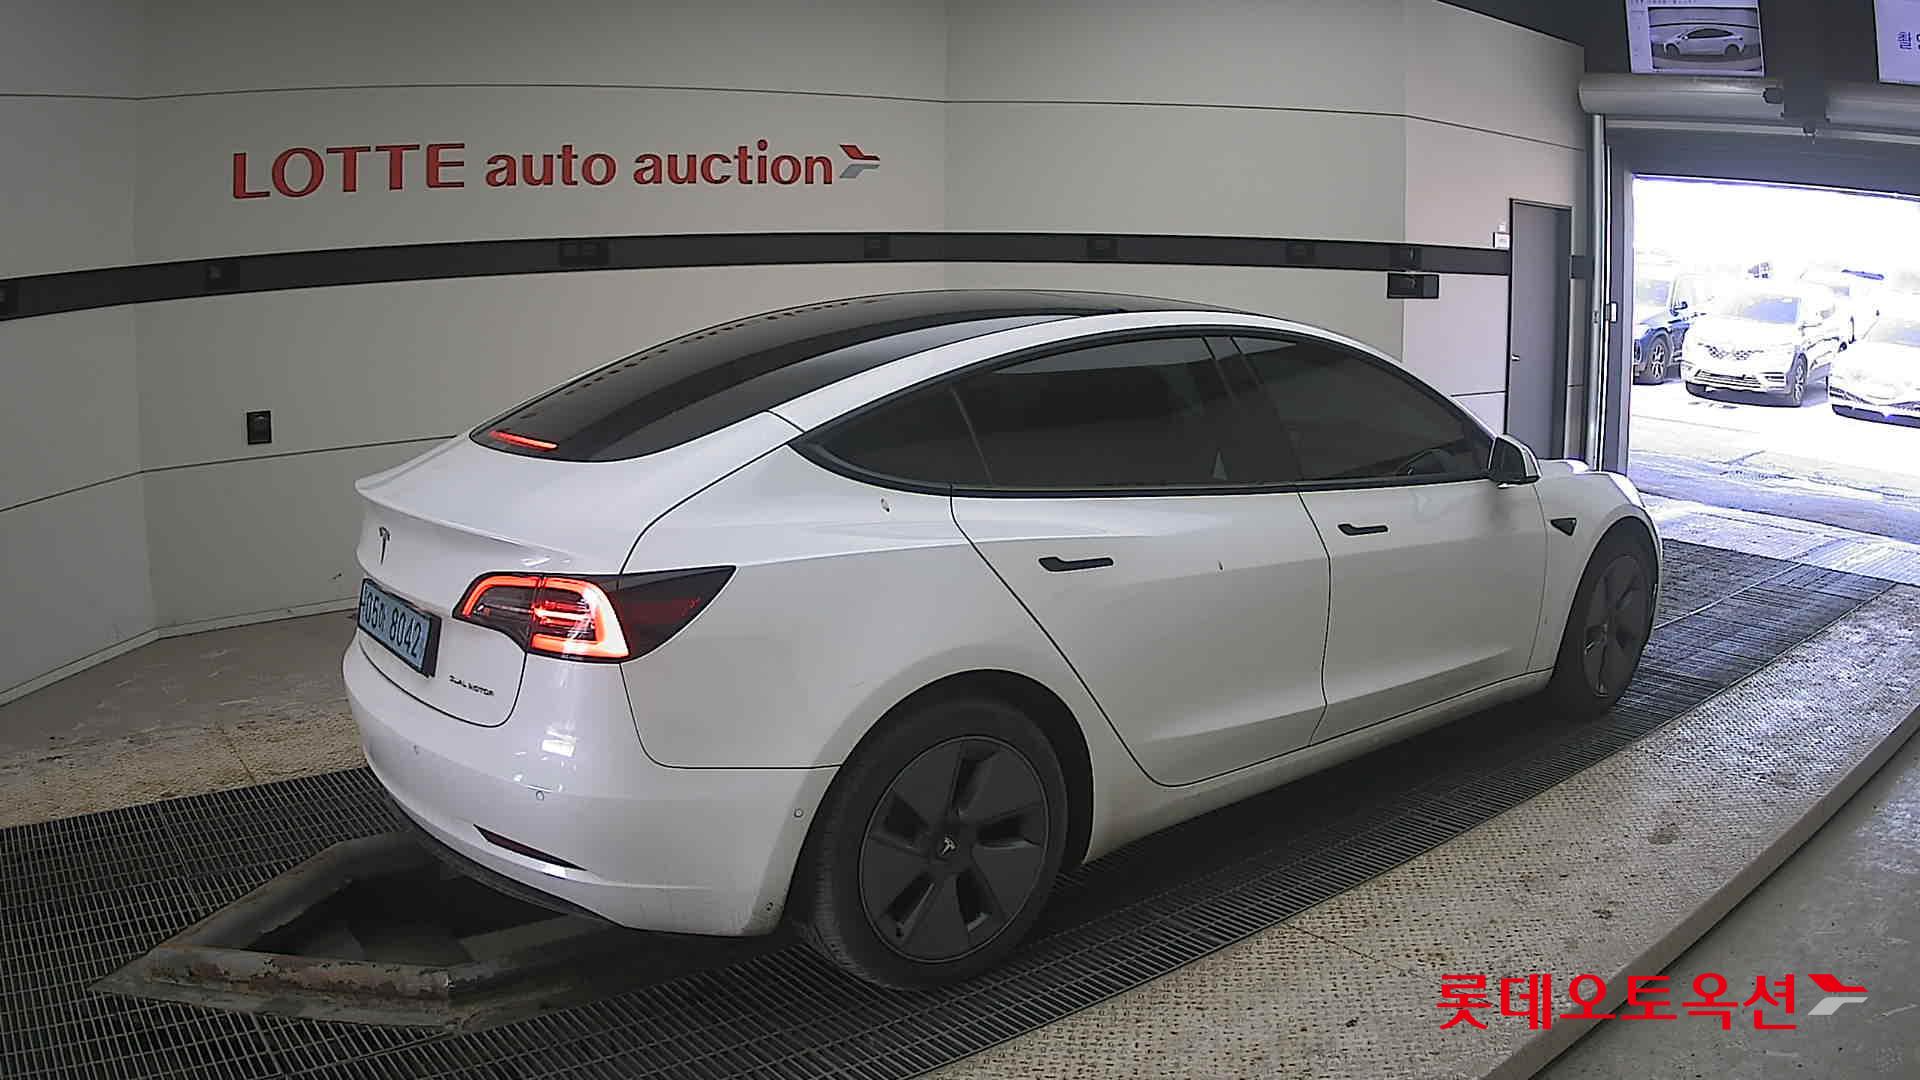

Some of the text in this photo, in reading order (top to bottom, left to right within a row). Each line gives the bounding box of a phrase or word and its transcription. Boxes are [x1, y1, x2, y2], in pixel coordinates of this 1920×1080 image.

[232, 139, 834, 200] LOTTE auto auction
[389, 607, 422, 658] 8042
